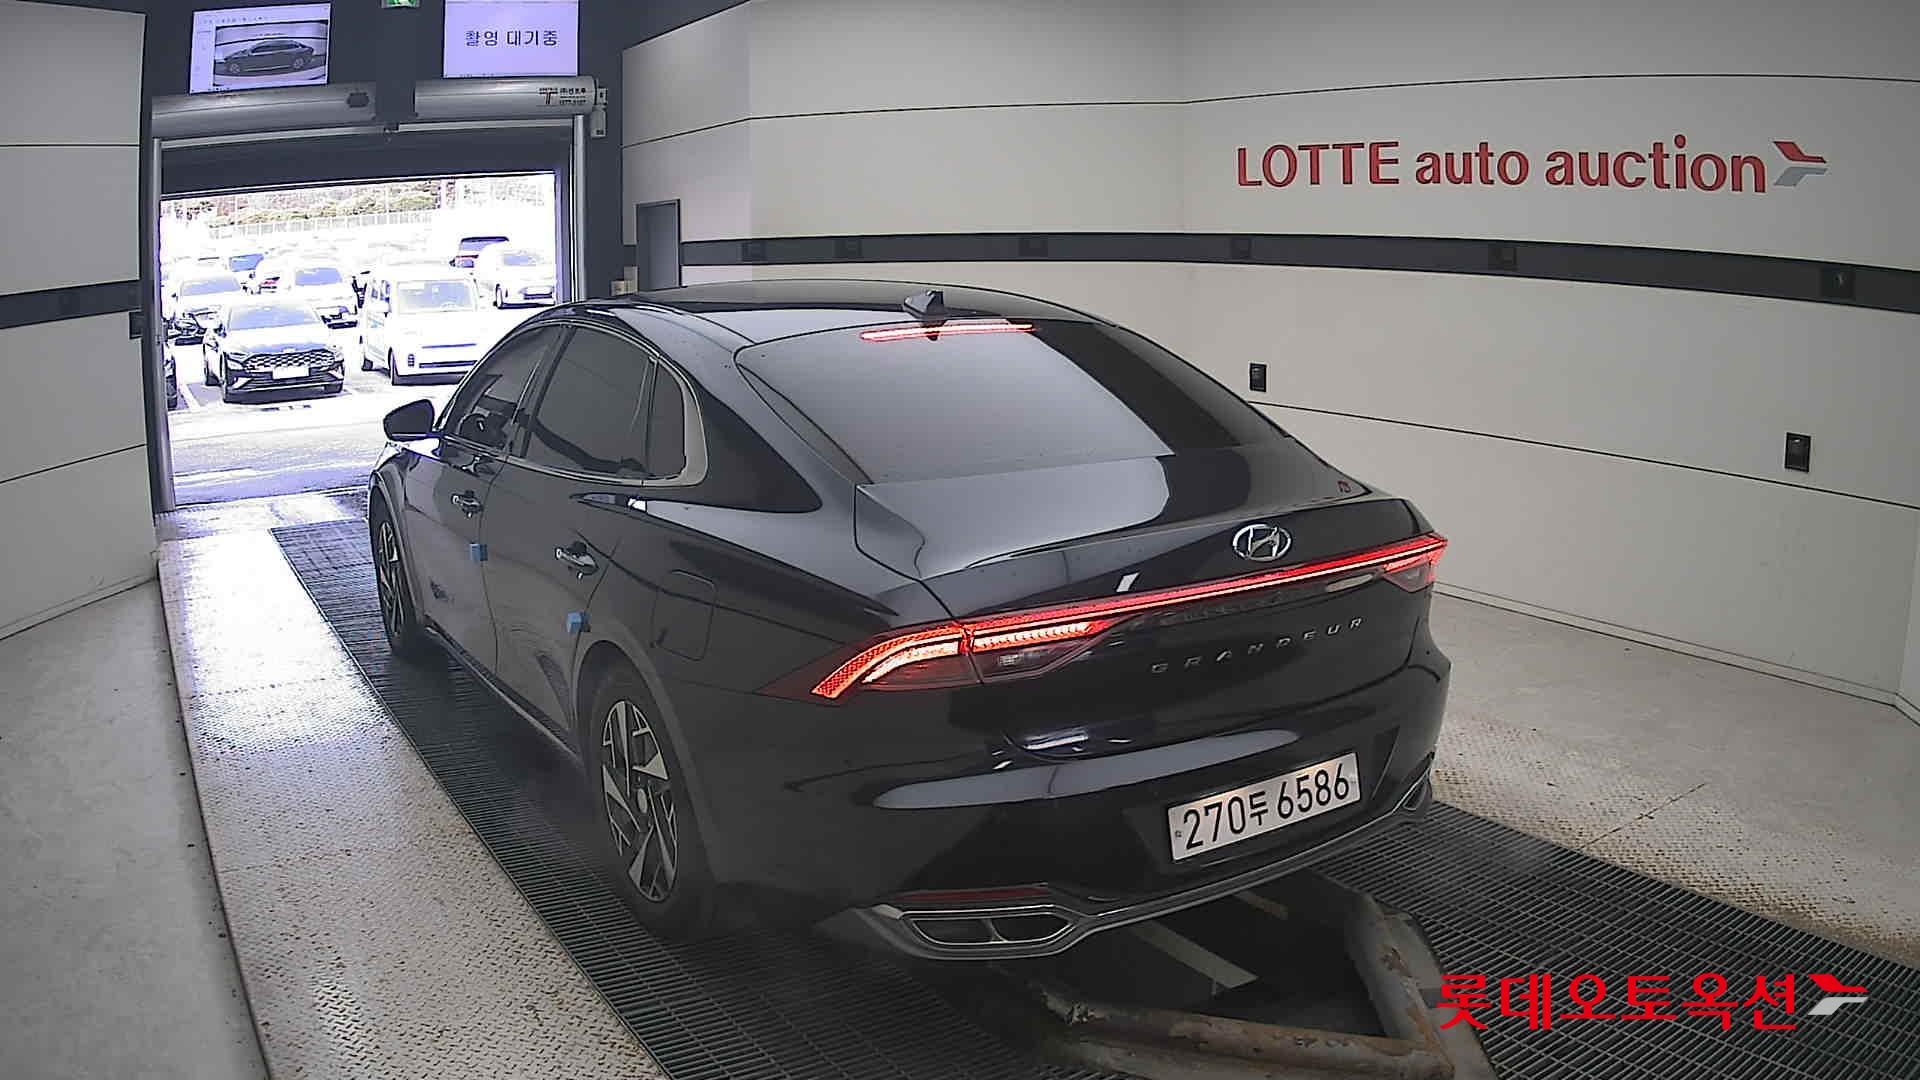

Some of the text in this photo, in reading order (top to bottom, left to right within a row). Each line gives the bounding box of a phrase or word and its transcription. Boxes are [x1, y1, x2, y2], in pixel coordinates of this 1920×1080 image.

[466, 30, 498, 46] 촬영
[1237, 135, 1766, 193] LOTTE auto auction
[1152, 617, 1362, 673] GRANDEUR
[1184, 763, 1349, 849] 270두 6586
